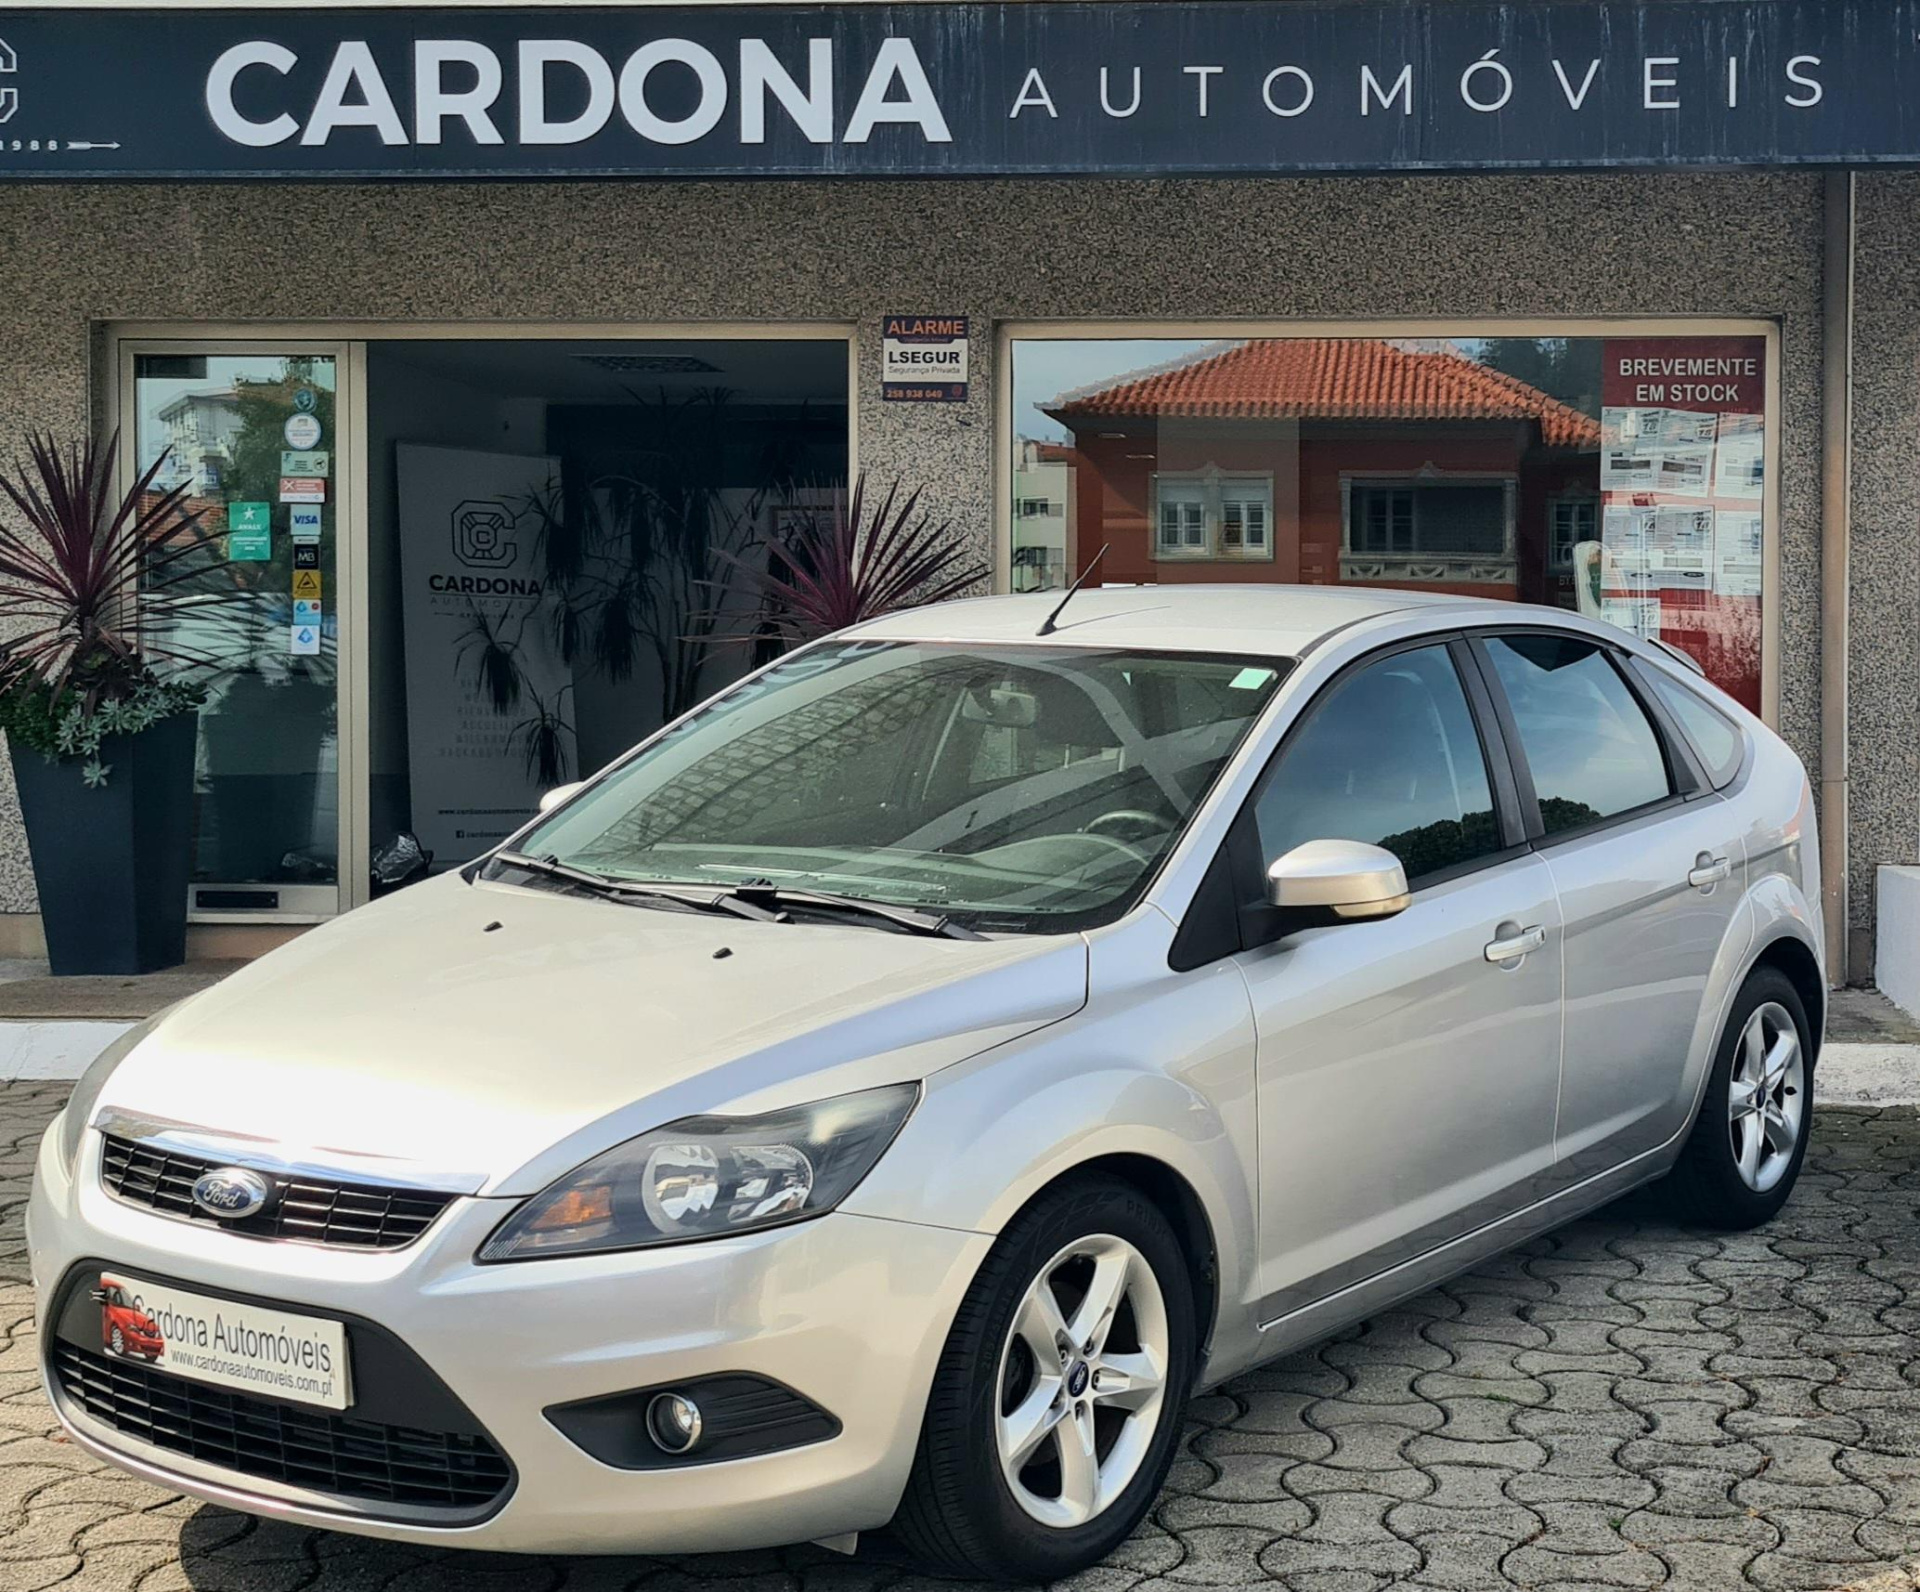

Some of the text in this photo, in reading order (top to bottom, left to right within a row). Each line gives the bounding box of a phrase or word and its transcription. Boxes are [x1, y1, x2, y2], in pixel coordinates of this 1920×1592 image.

[206, 37, 1823, 147] CARDONA AUTOMÓVEIS
[887, 320, 965, 335] ALARME
[888, 351, 960, 364] LSEGUR
[888, 366, 961, 375] Segurança Privada
[1620, 358, 1757, 376] BREVEMENTE
[1636, 384, 1739, 402] EM STOCK
[293, 514, 319, 525] VISA
[298, 551, 315, 562] MB
[429, 574, 542, 596] CARDONA
[203, 1180, 242, 1208] Ford
[132, 1294, 332, 1374] Cardona Automóveis
[171, 1348, 334, 1399] www.cardonaautomoveis.com.pt
